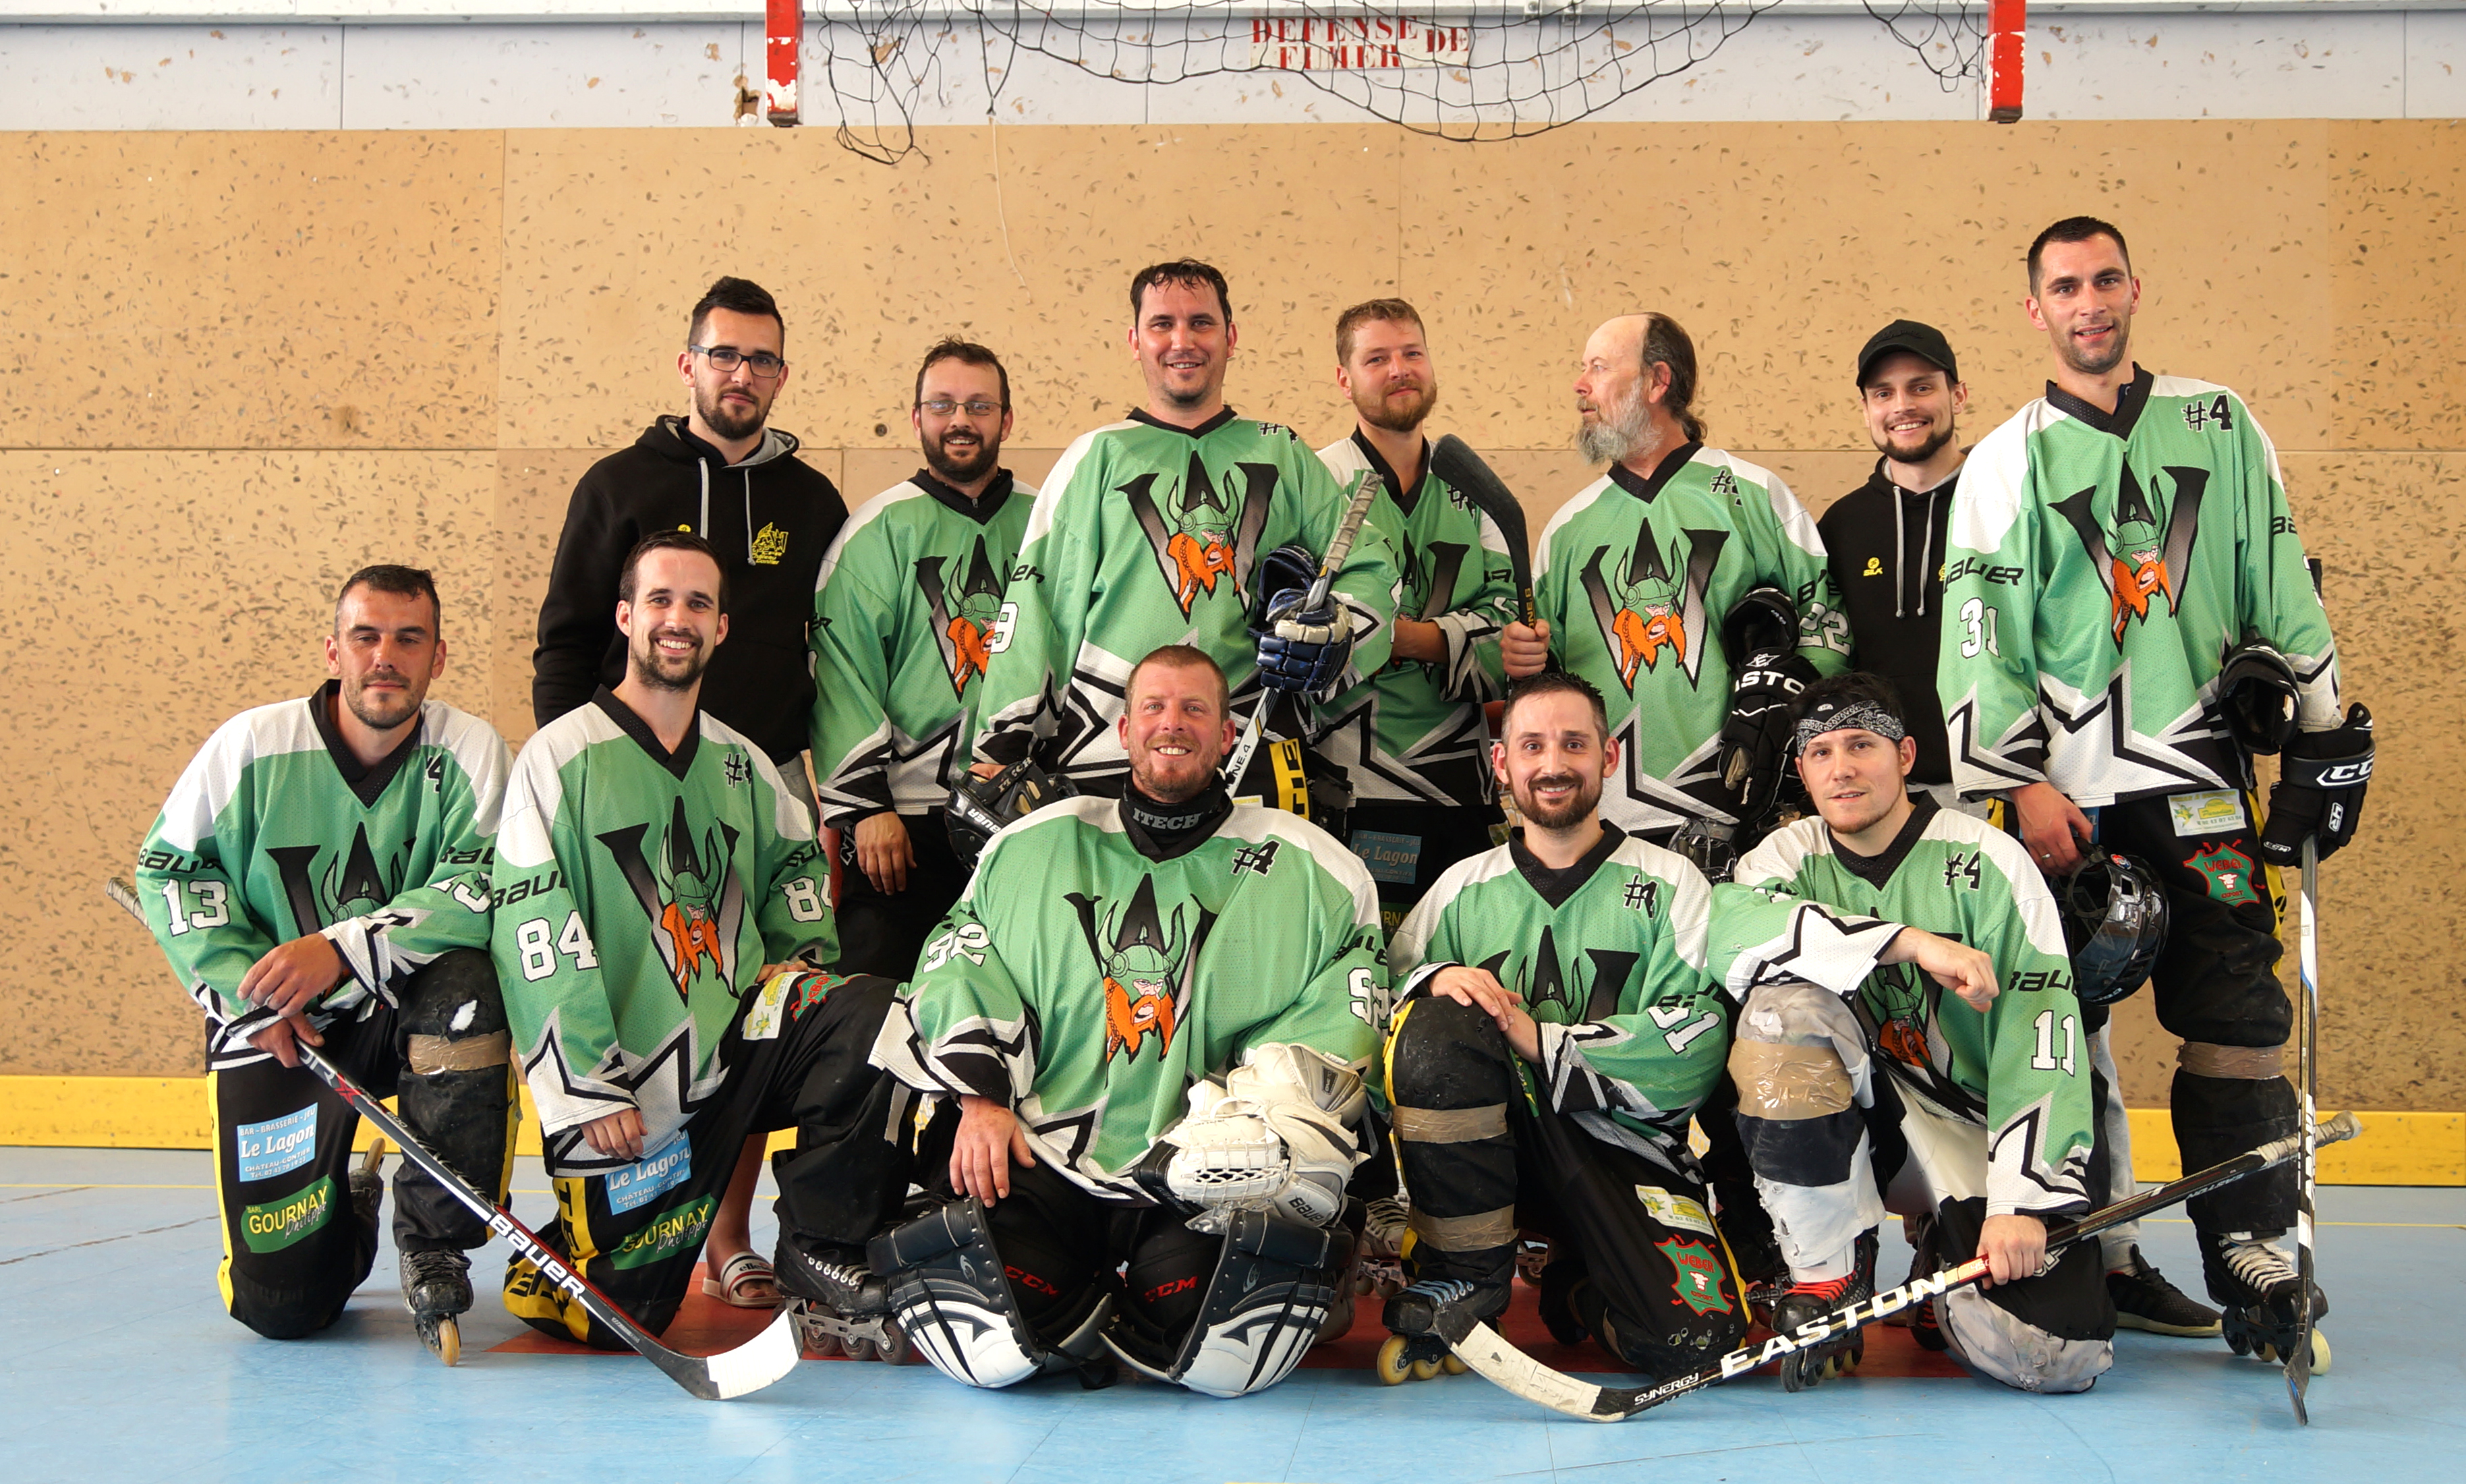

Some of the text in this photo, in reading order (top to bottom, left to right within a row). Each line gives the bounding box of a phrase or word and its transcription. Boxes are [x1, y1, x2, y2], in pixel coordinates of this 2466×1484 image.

[1251, 15, 1469, 53] DEFENSE DE
[1798, 601, 1851, 657] 22
[967, 807, 1002, 834] AUER
[1132, 807, 1200, 830] ITECH
[1374, 846, 1418, 867] Lagon
[2204, 857, 2244, 873] WEBER
[162, 878, 231, 938] 13
[516, 910, 600, 982] 84
[2032, 1009, 2076, 1078] 11
[240, 1126, 255, 1137] BAR
[260, 1114, 299, 1134] BRASSERIE
[304, 1106, 316, 1121] JEU
[241, 1123, 315, 1158] Le Lagon
[609, 1172, 631, 1191] Le
[635, 1147, 691, 1181] Lagon
[249, 1185, 328, 1234] GOURNAY
[489, 1214, 586, 1300] BAUER
[1676, 1251, 1716, 1274] WEBER
[1004, 1265, 1059, 1298] CCM
[1144, 1275, 1199, 1303] CCM
[1719, 1270, 1947, 1379] EASTON
[1634, 1371, 1699, 1407] SYNERGY
